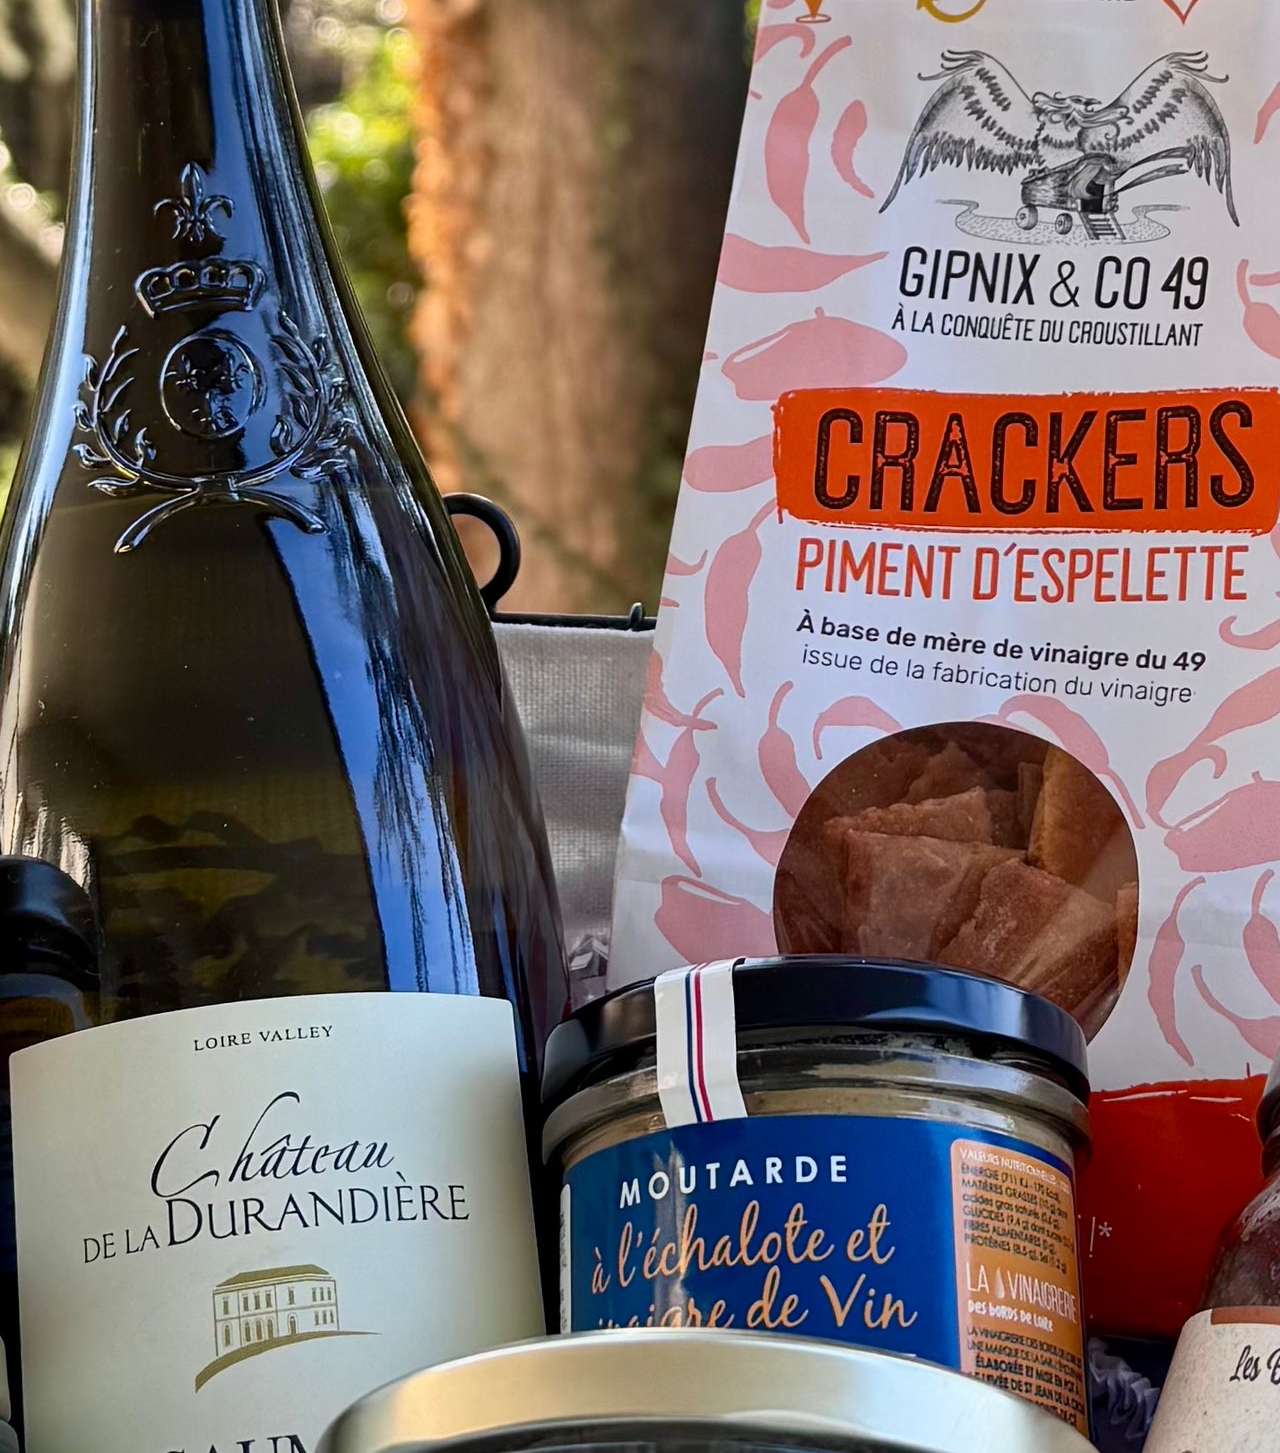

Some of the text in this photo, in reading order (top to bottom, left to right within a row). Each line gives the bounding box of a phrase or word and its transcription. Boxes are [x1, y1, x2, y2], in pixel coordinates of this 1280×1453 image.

[898, 247, 1210, 311] GIPNIX & CO 49
[892, 303, 1204, 348] À LA CONQUÊTE DU CROUSTILLANT
[813, 400, 1256, 515] CRACKERS
[795, 538, 1250, 604] PIMENT D'ESPELETTE
[796, 608, 1207, 674] À base de mère de vinaigre du 49
[801, 643, 1193, 706] issue de la fabrication du vinaigre
[194, 1025, 334, 1051] LOIRE VALLEY
[150, 1091, 396, 1198] Château
[620, 1155, 848, 1209] MOUTARDE
[84, 1171, 471, 1264] DE LA DURANDIÈRE
[591, 1247, 612, 1295] à
[617, 1200, 835, 1289] l'échalote
[847, 1203, 895, 1265] et
[747, 1265, 809, 1329] de
[820, 1273, 918, 1331] Vin
[966, 1262, 1077, 1323] LA VINAIGRERIE
[1230, 1345, 1261, 1383] Les
